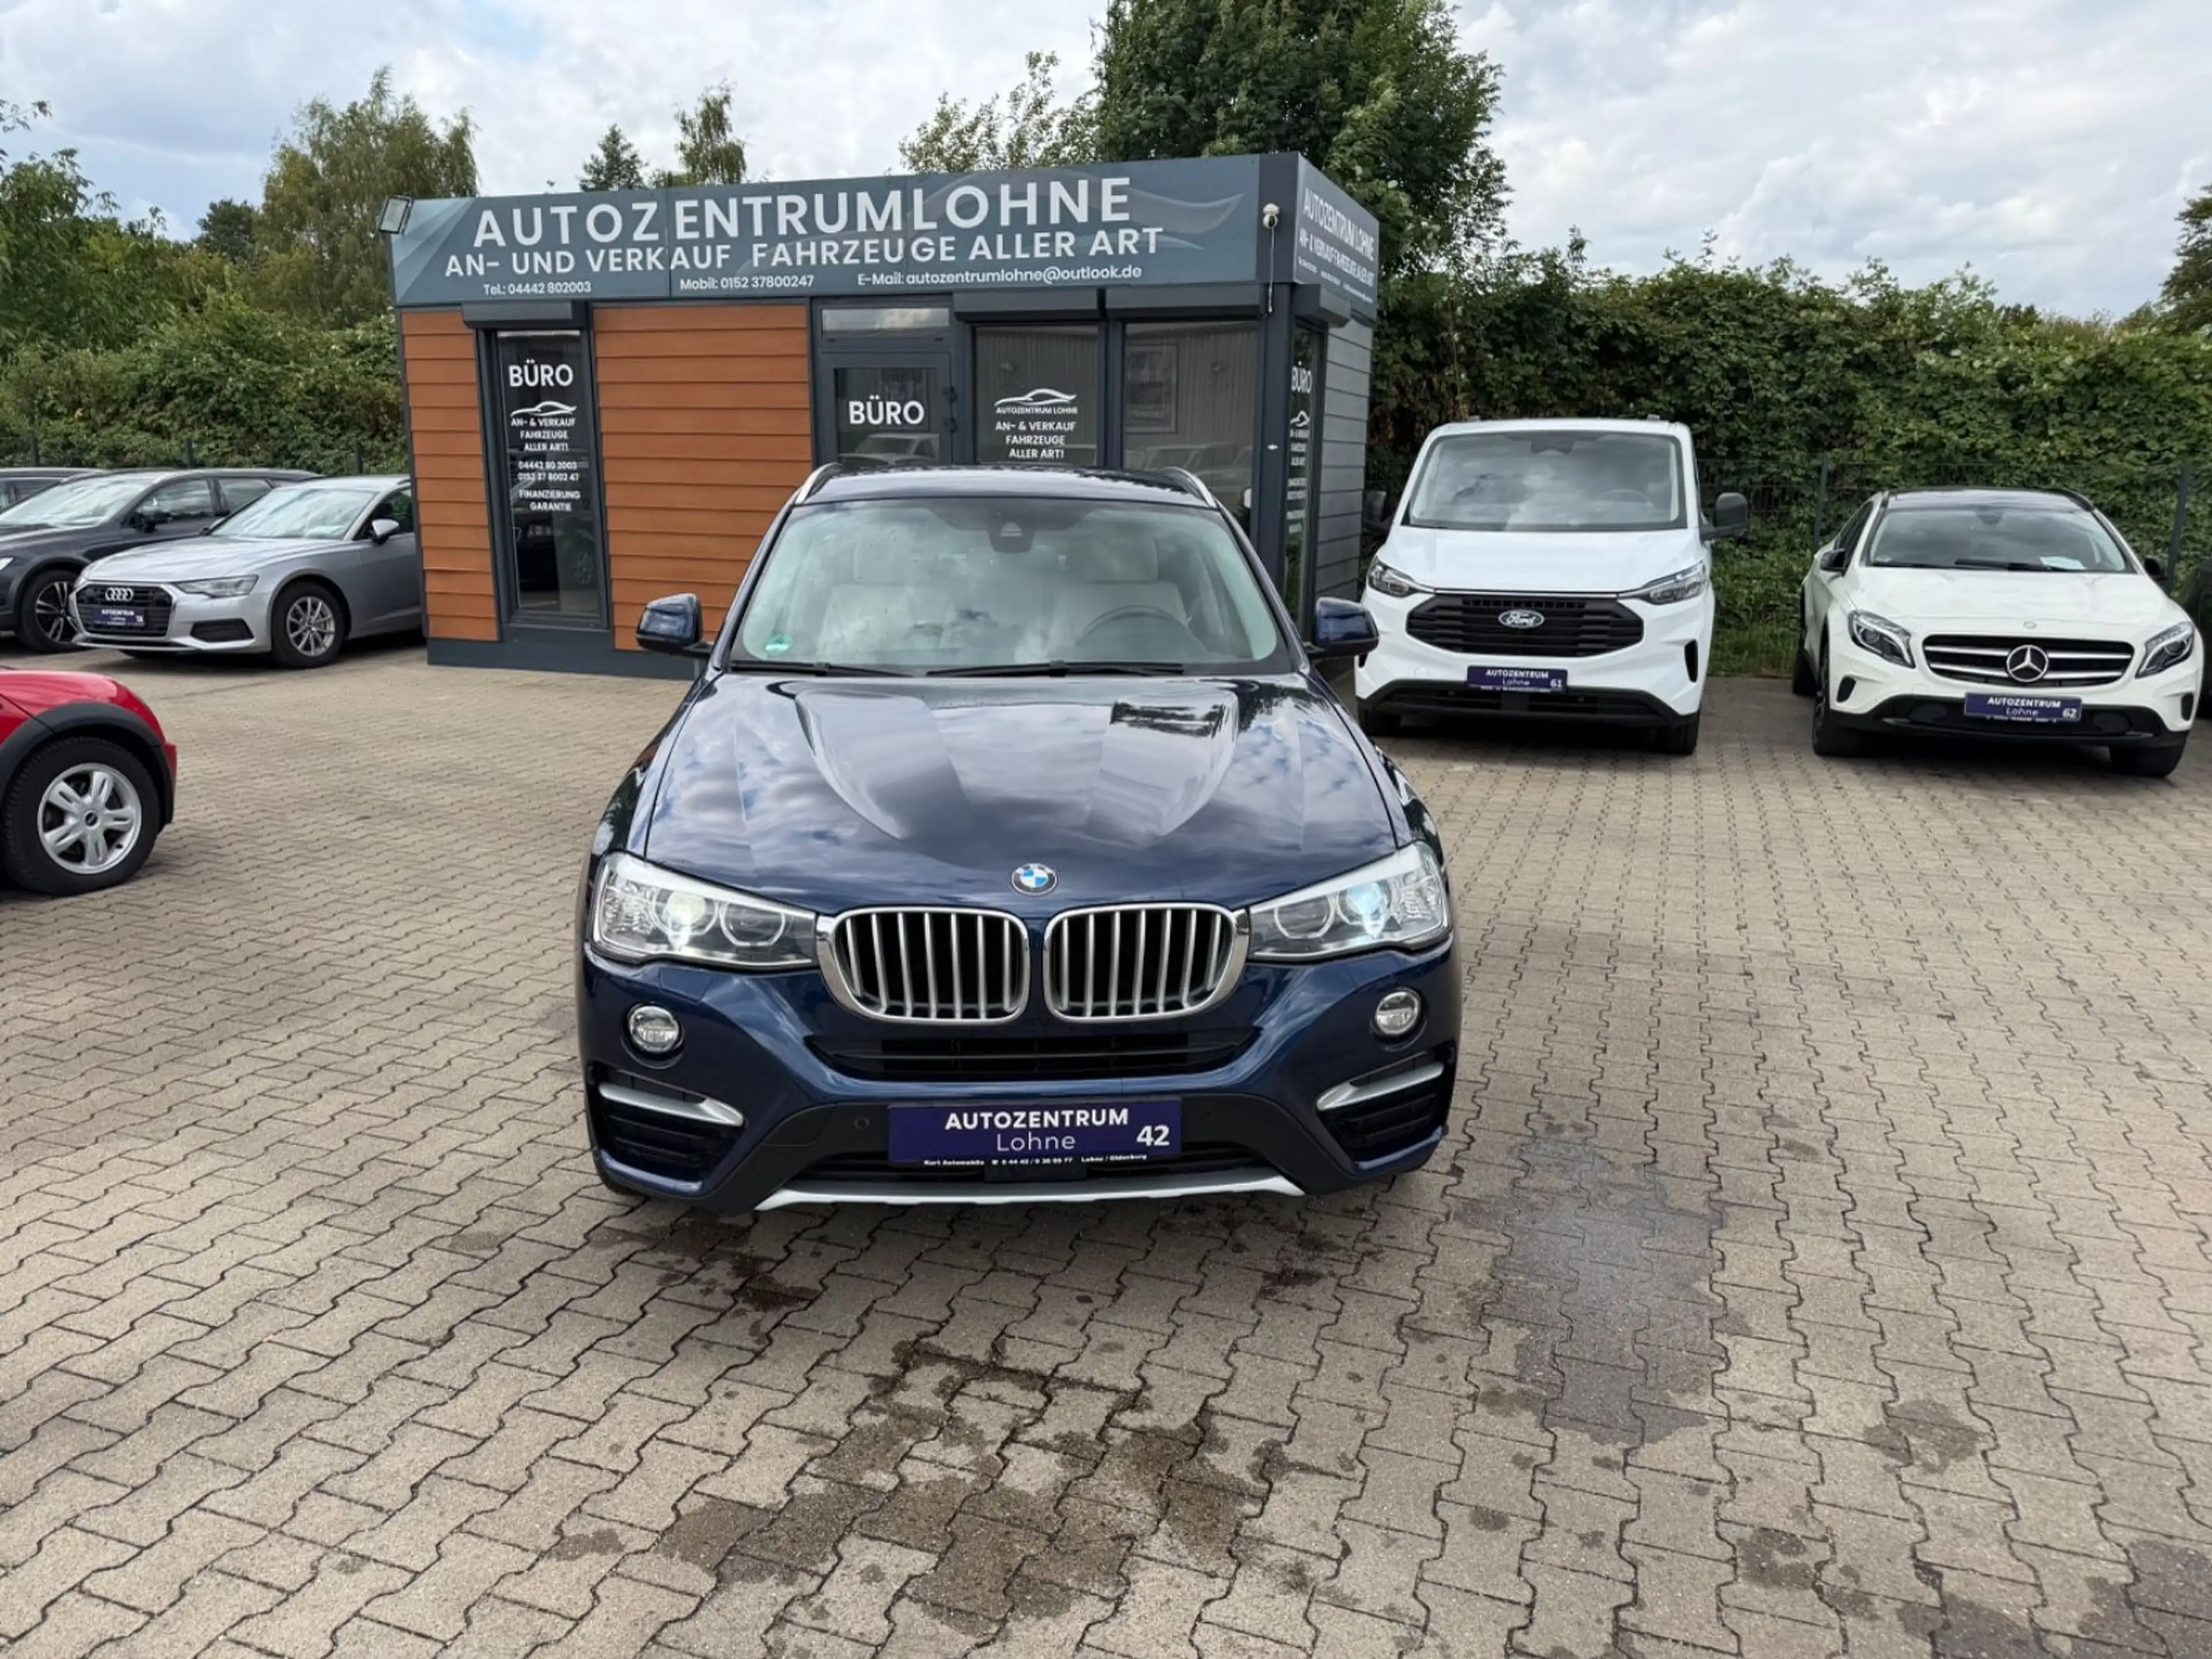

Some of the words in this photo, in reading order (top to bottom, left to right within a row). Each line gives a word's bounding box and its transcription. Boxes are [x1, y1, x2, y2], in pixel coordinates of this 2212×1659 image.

[445, 253, 500, 276] AN-
[512, 249, 574, 275] UND
[585, 244, 731, 273] VERKAUF
[752, 235, 956, 268] FAHRZEUGE
[968, 230, 1076, 260] ALLER
[1089, 227, 1164, 256] ART
[858, 272, 904, 285] E-Mail:
[906, 265, 1142, 285] autozentrumlohne@outlook.de
[680, 277, 718, 290] Mobil:
[721, 276, 748, 289] 0152
[751, 274, 815, 288] 37800247
[507, 282, 545, 295] 04442
[547, 281, 591, 294] 802003
[509, 358, 574, 387] BÜRO
[848, 395, 925, 425] BÜRO
[996, 406, 1052, 415] AUTOZENTRUM
[1054, 406, 1078, 415] LOHNE
[511, 417, 527, 427] AN-
[529, 417, 536, 427] &
[538, 417, 576, 427] VERKAUF
[995, 421, 1016, 431] AN-
[1018, 421, 1027, 431] &
[1029, 421, 1077, 431] VERKAUF
[520, 430, 569, 440] FAHRZEUGE
[1005, 435, 1066, 445] FAHRZEUGE
[524, 442, 547, 452] ALLER
[1009, 448, 1037, 459] ALLER
[1040, 449, 1065, 459] ART!
[529, 502, 573, 512] GARANTIE
[1486, 669, 1549, 679] AUTOZENTRUM
[1987, 696, 2061, 708] AUTOZENTRUM
[2006, 707, 2039, 716] Lohne
[945, 1108, 1129, 1130] AUTOZENTRUM
[1136, 1125, 1171, 1146] 42
[997, 1131, 1076, 1152] Lohne
